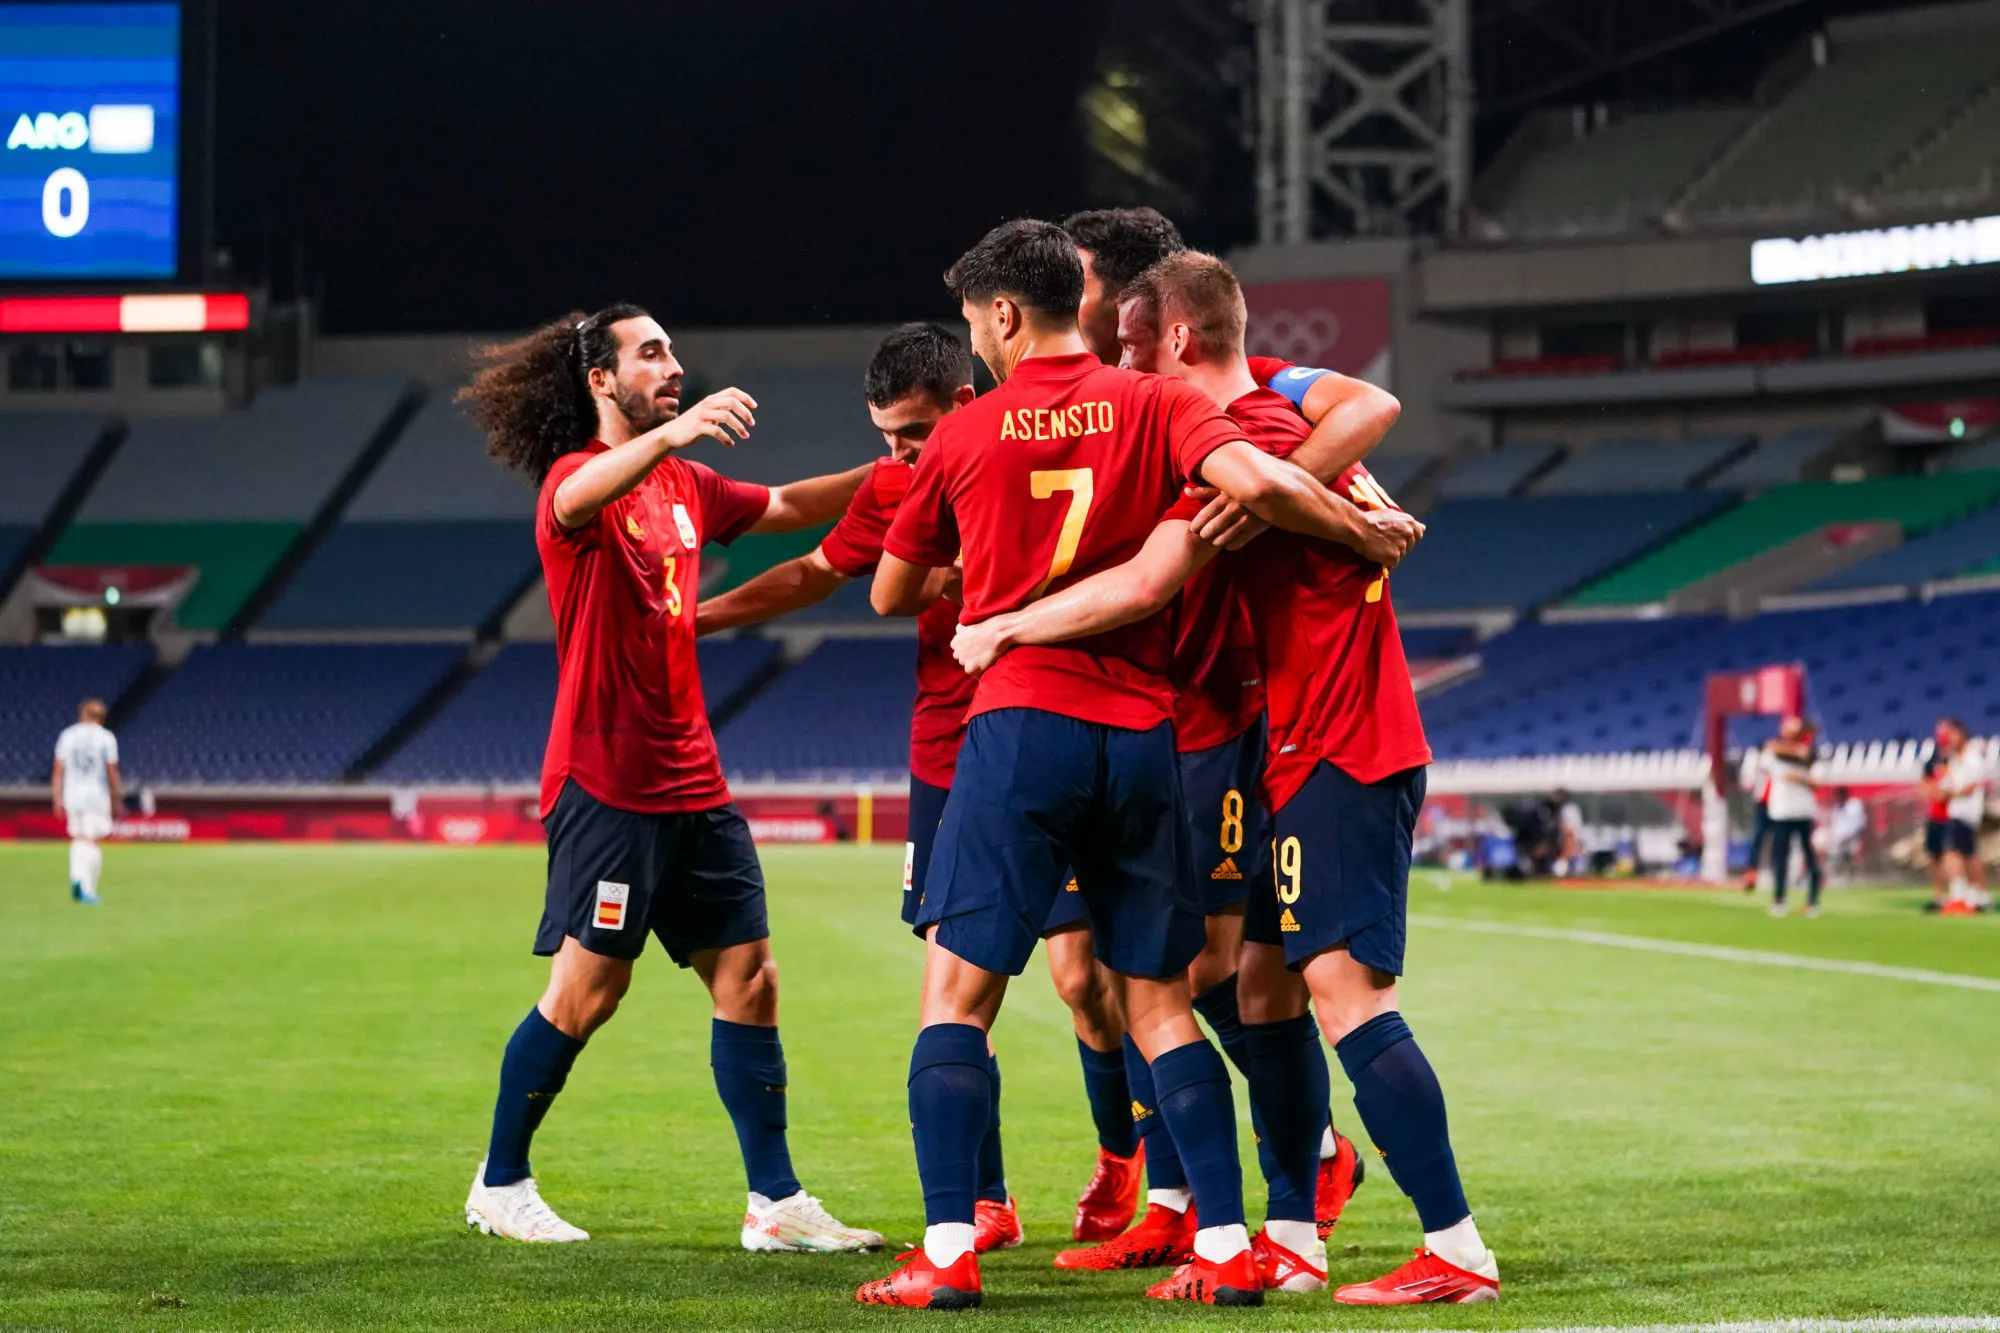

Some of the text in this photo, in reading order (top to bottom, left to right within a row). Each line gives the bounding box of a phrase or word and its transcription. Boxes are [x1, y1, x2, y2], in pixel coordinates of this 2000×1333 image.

[41, 167, 90, 238] 0
[1000, 400, 1114, 441] ASENSIO
[1029, 467, 1094, 600] 7
[663, 557, 682, 617] 3
[1220, 789, 1243, 853] 8
[1210, 870, 1242, 880] adidas
